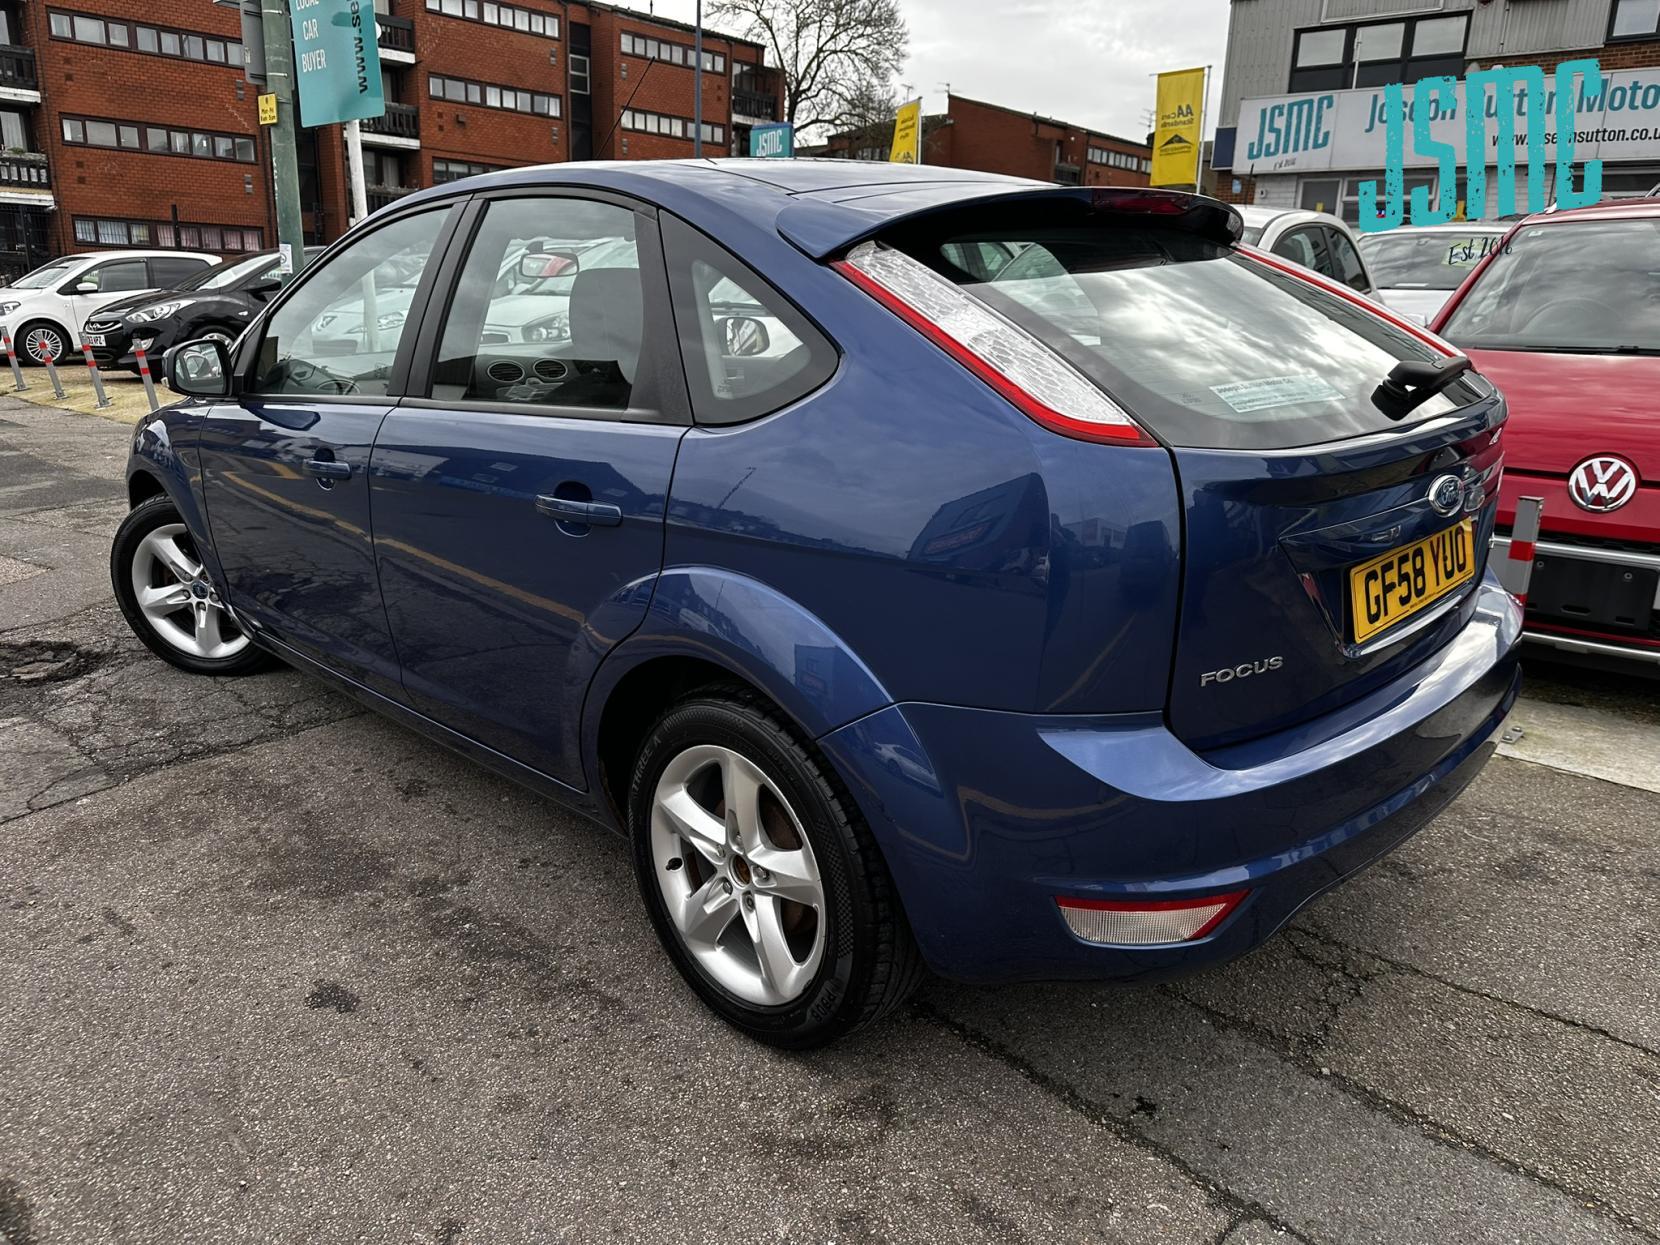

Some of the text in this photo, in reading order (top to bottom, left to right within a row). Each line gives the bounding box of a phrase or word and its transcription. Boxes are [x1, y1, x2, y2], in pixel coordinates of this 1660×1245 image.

[302, 18, 319, 41] CAR
[301, 49, 327, 73] BUYER
[346, 0, 369, 95] www.se
[756, 129, 783, 157] JSMC
[1247, 94, 1334, 160] JSMC
[1364, 525, 1467, 625] GF58 YUO
[1200, 656, 1284, 688] FOCUS
